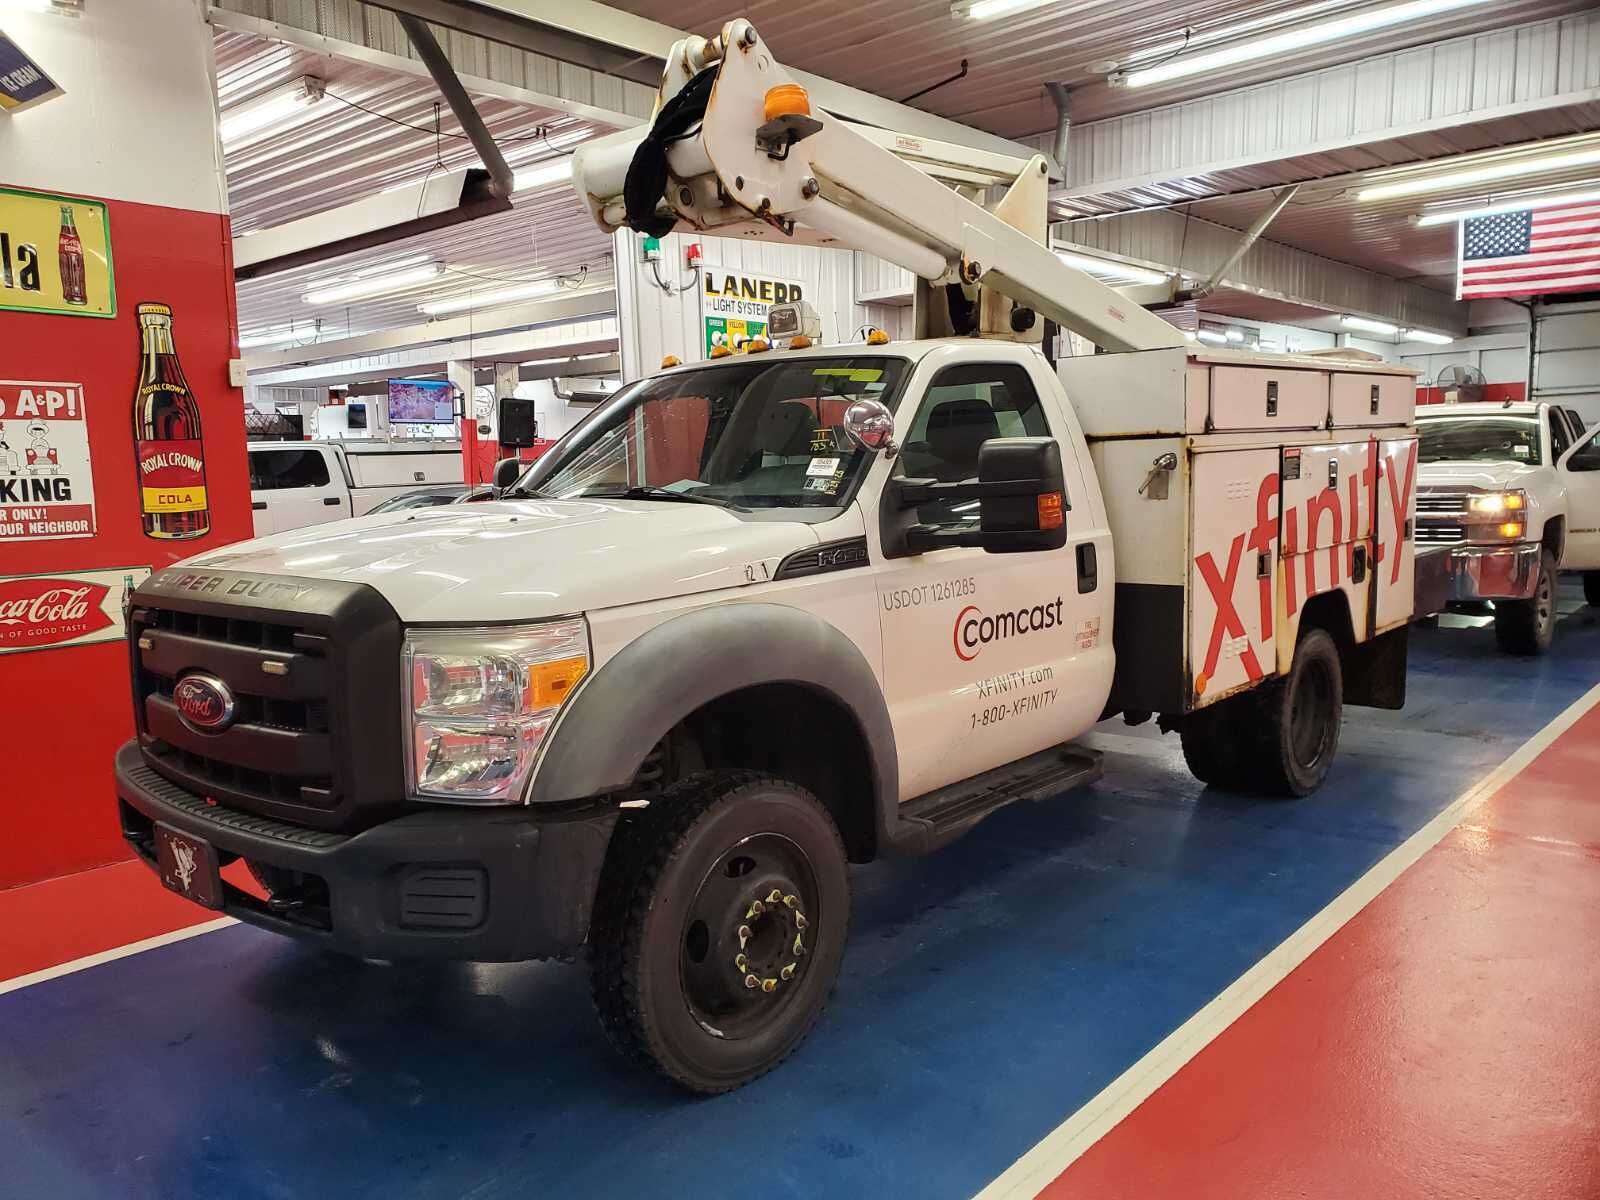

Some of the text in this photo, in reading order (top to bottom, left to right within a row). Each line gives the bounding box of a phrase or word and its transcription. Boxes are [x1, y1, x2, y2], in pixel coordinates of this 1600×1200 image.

[713, 299, 735, 313] LIGHT
[142, 382, 186, 396] ROYAL CROWN
[15, 389, 76, 417] A&P!
[141, 452, 203, 475] ROYAL CROWN
[158, 494, 193, 505] COLA
[12, 508, 47, 520] ONLY!
[29, 520, 89, 534] NEIGHBOR
[156, 573, 314, 601] SUPER DUTY
[882, 576, 977, 611] USDOT 1261285
[27, 626, 58, 637] GOOD
[61, 623, 88, 633] TASTE
[975, 665, 1054, 701] XFINITY.com
[179, 684, 212, 716] Ford
[970, 688, 1059, 729] 1-800-XFINITY
